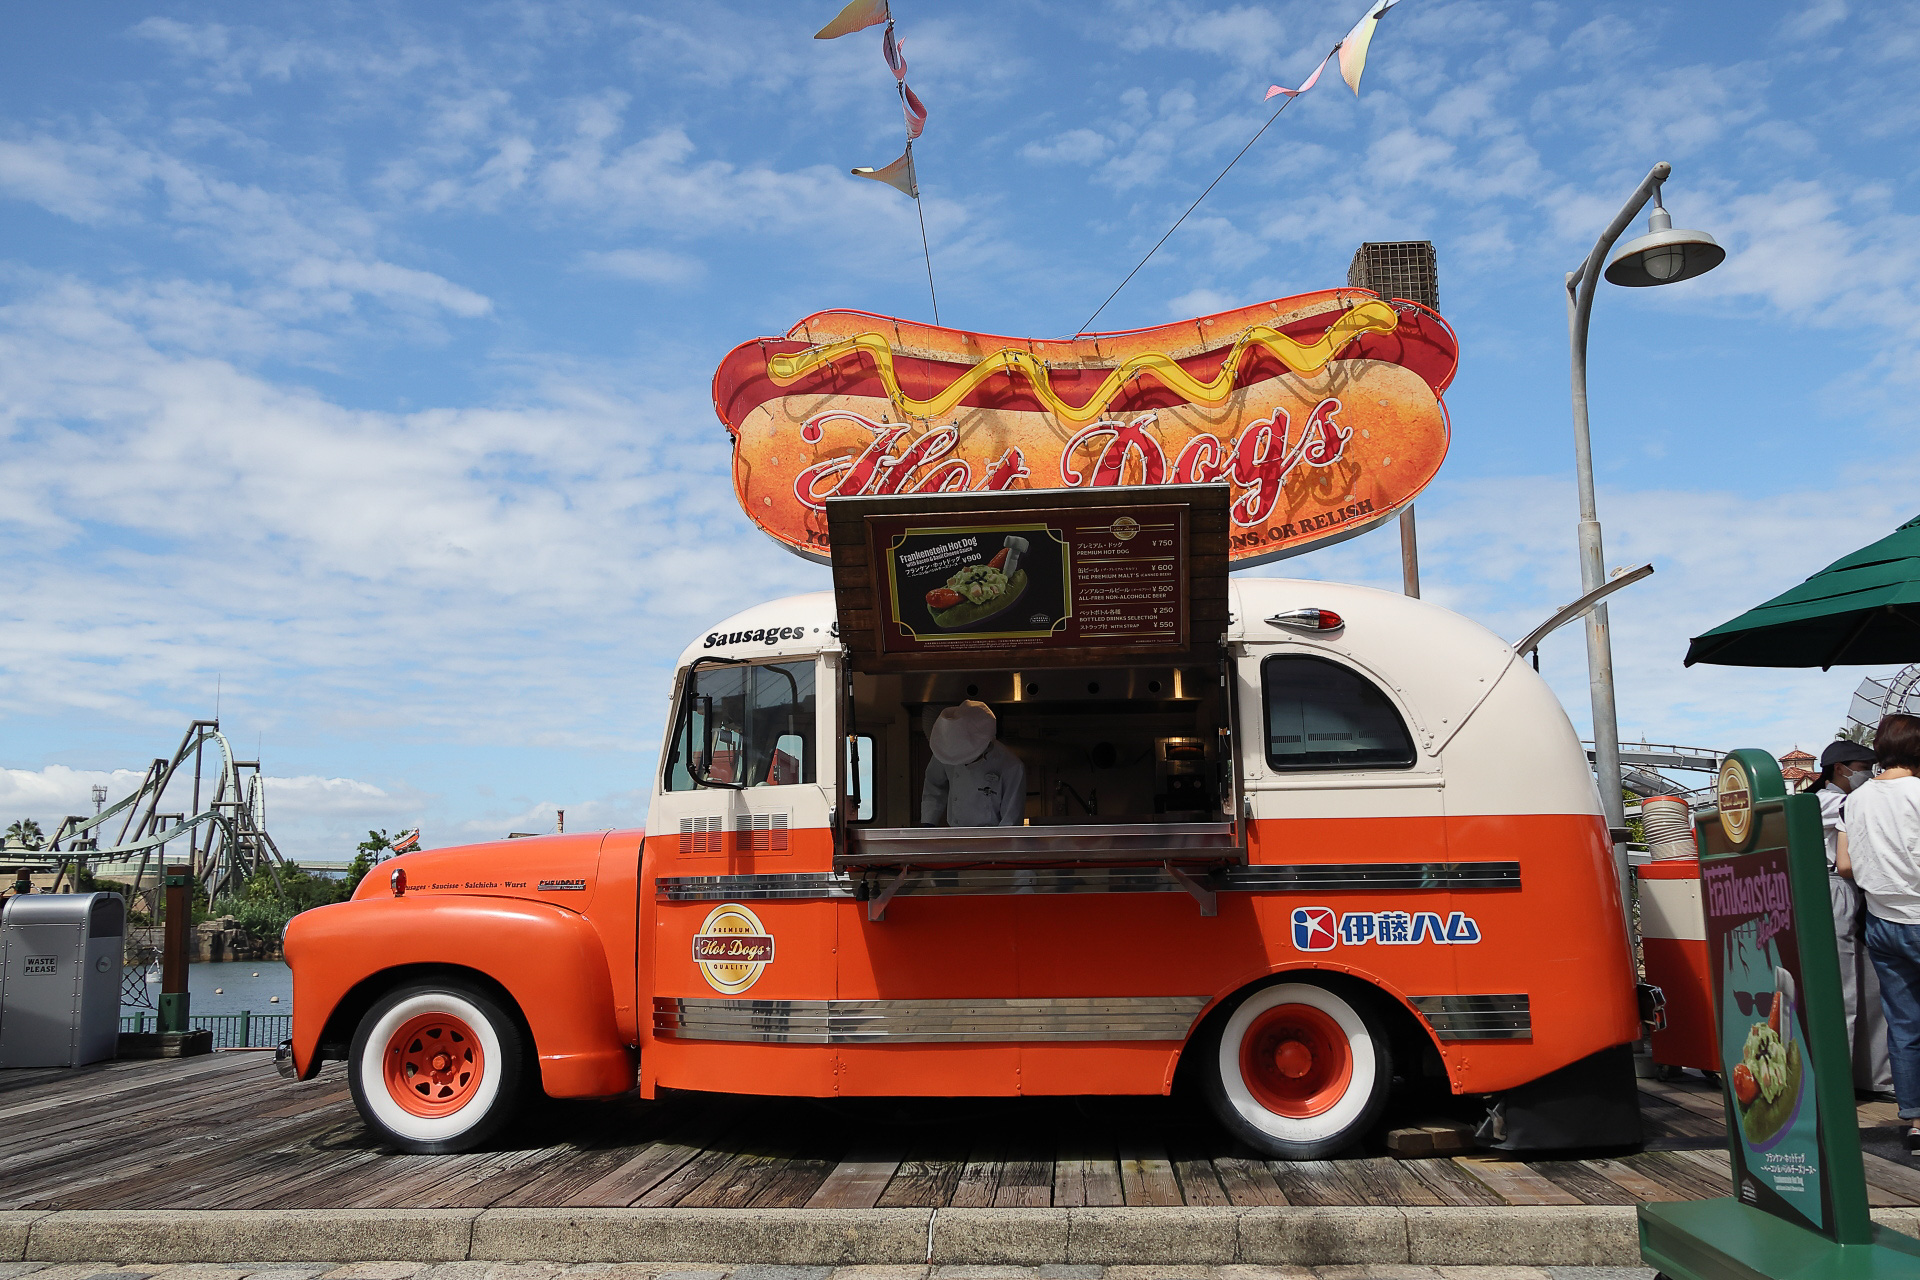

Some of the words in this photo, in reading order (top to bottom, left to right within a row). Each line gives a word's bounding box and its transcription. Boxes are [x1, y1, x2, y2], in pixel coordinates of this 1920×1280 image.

[1060, 397, 1353, 528] Dogs
[1229, 532, 1267, 549] NS,
[1267, 523, 1298, 541] OR
[1299, 499, 1375, 534] RELISH
[900, 544, 948, 564] Frankenstein
[948, 540, 962, 551] Hot
[961, 536, 978, 548] Dog
[962, 552, 982, 564] ¥900
[703, 626, 805, 648] Sausages
[1703, 862, 1790, 917] Frankenstein
[1340, 913, 1480, 943] 伊藤ハム
[700, 940, 726, 955] Hot
[728, 940, 764, 960] Dogs
